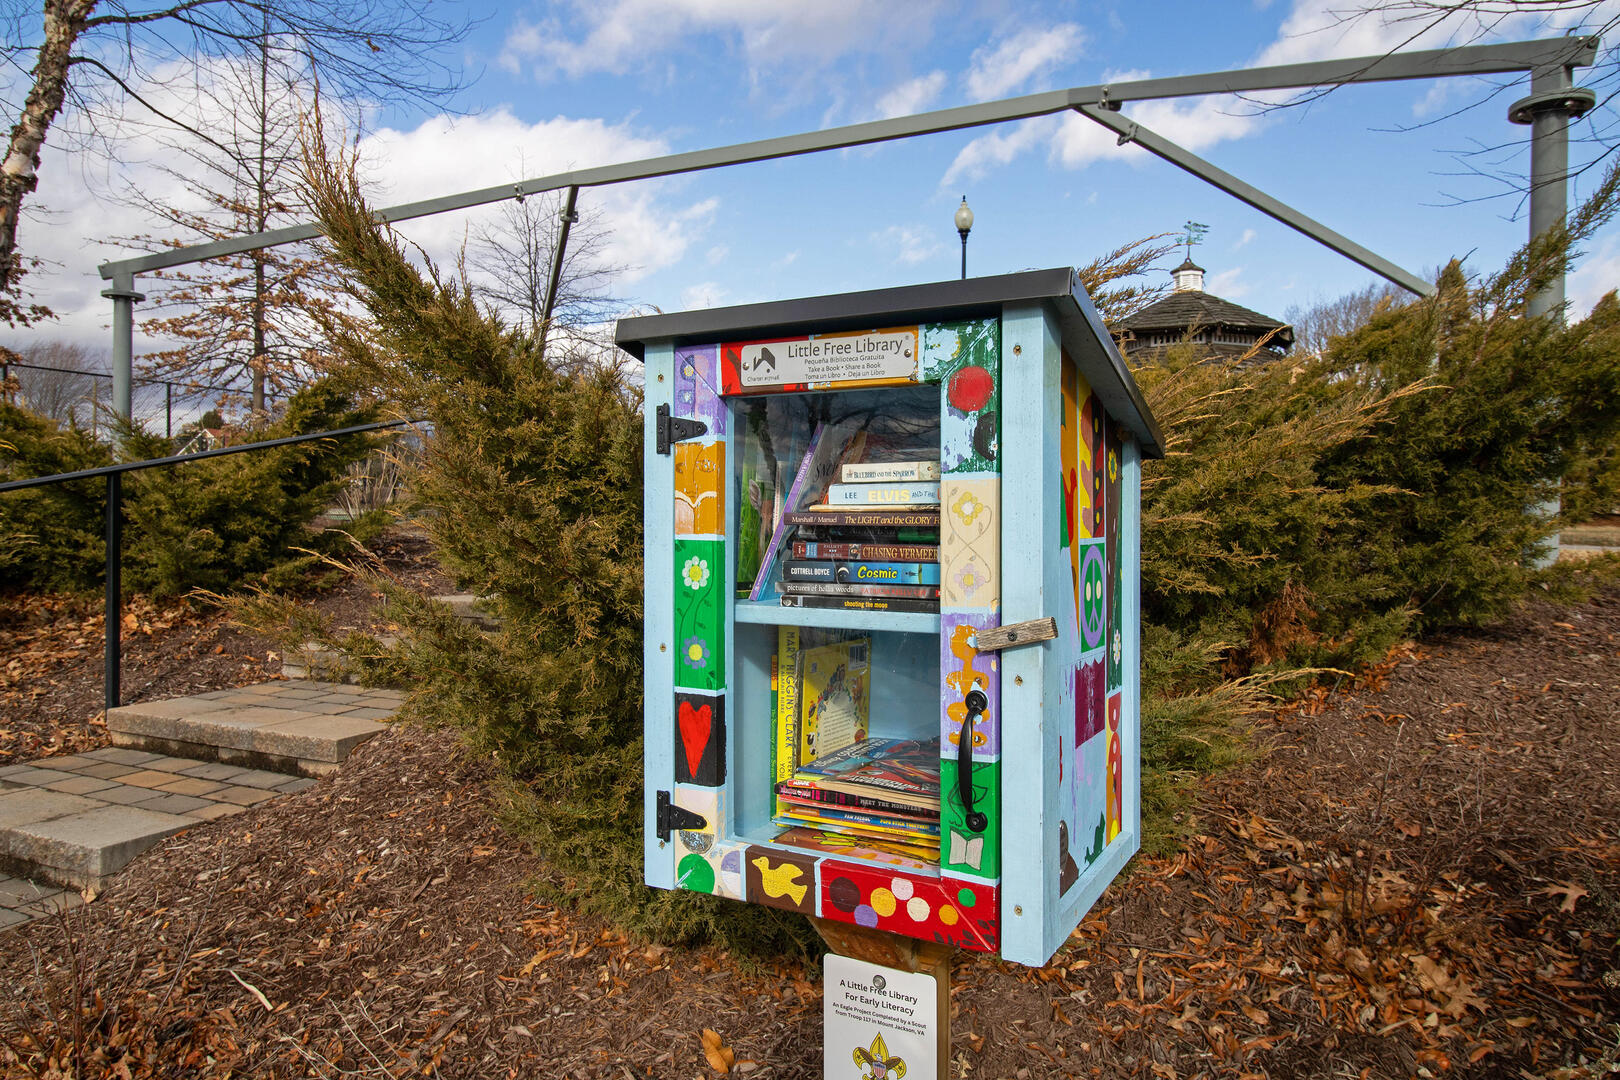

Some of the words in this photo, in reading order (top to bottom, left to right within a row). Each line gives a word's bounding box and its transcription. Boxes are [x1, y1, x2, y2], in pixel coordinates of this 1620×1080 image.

[788, 342, 820, 358] Little
[824, 342, 852, 356] Free
[856, 338, 903, 354] Library
[868, 488, 910, 502] ELVIS
[844, 516, 857, 524] The
[857, 516, 880, 524] LIGHT
[880, 516, 894, 524] and
[894, 516, 904, 524] the
[904, 516, 932, 524] GLORY
[862, 546, 898, 558] CHASING
[899, 548, 938, 560] VERMEER
[790, 568, 814, 576] COTTRELL
[857, 566, 898, 579] Cosmic
[844, 600, 864, 608] shooting
[786, 632, 796, 660] MARY
[786, 664, 796, 710] HIGGINS
[840, 979, 846, 987] A
[848, 980, 868, 992] Little
[870, 986, 888, 996] Free
[889, 990, 918, 1005] Library
[846, 992, 859, 1002] For
[860, 995, 880, 1008] Early
[882, 1000, 914, 1016] Literacy
[840, 1004, 854, 1012] Eagle
[854, 1006, 872, 1016] Project
[872, 1011, 900, 1022] Completed
[912, 1020, 926, 1030] Scout
[848, 1012, 862, 1021] Troop
[878, 1020, 894, 1028] Mount
[894, 1024, 916, 1034] Jackson,
